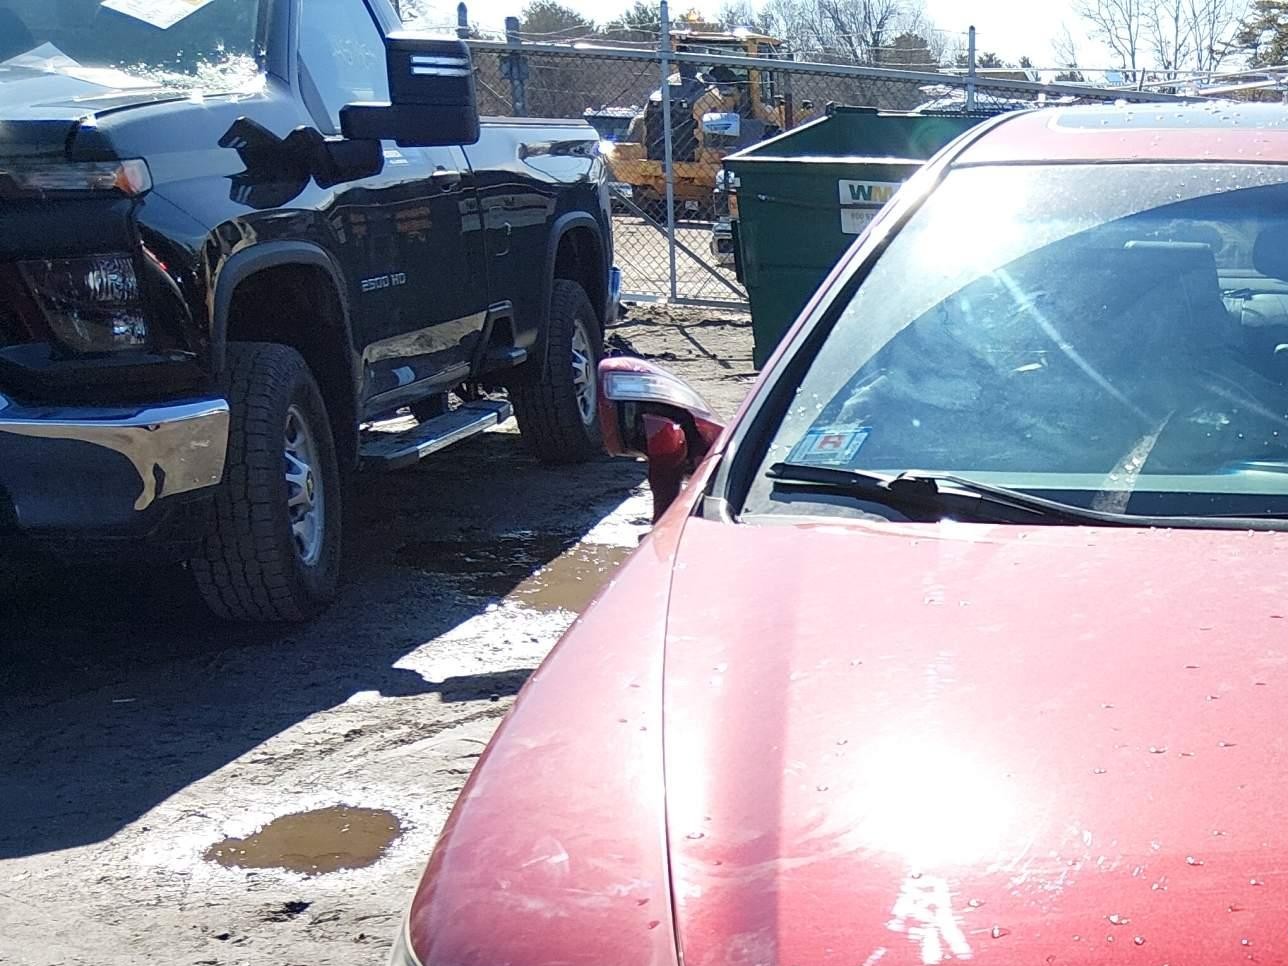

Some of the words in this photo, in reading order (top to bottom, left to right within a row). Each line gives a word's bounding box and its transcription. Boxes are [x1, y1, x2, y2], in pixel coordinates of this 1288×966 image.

[848, 184, 893, 201] WM
[361, 276, 390, 292] 2500
[390, 272, 407, 286] HD
